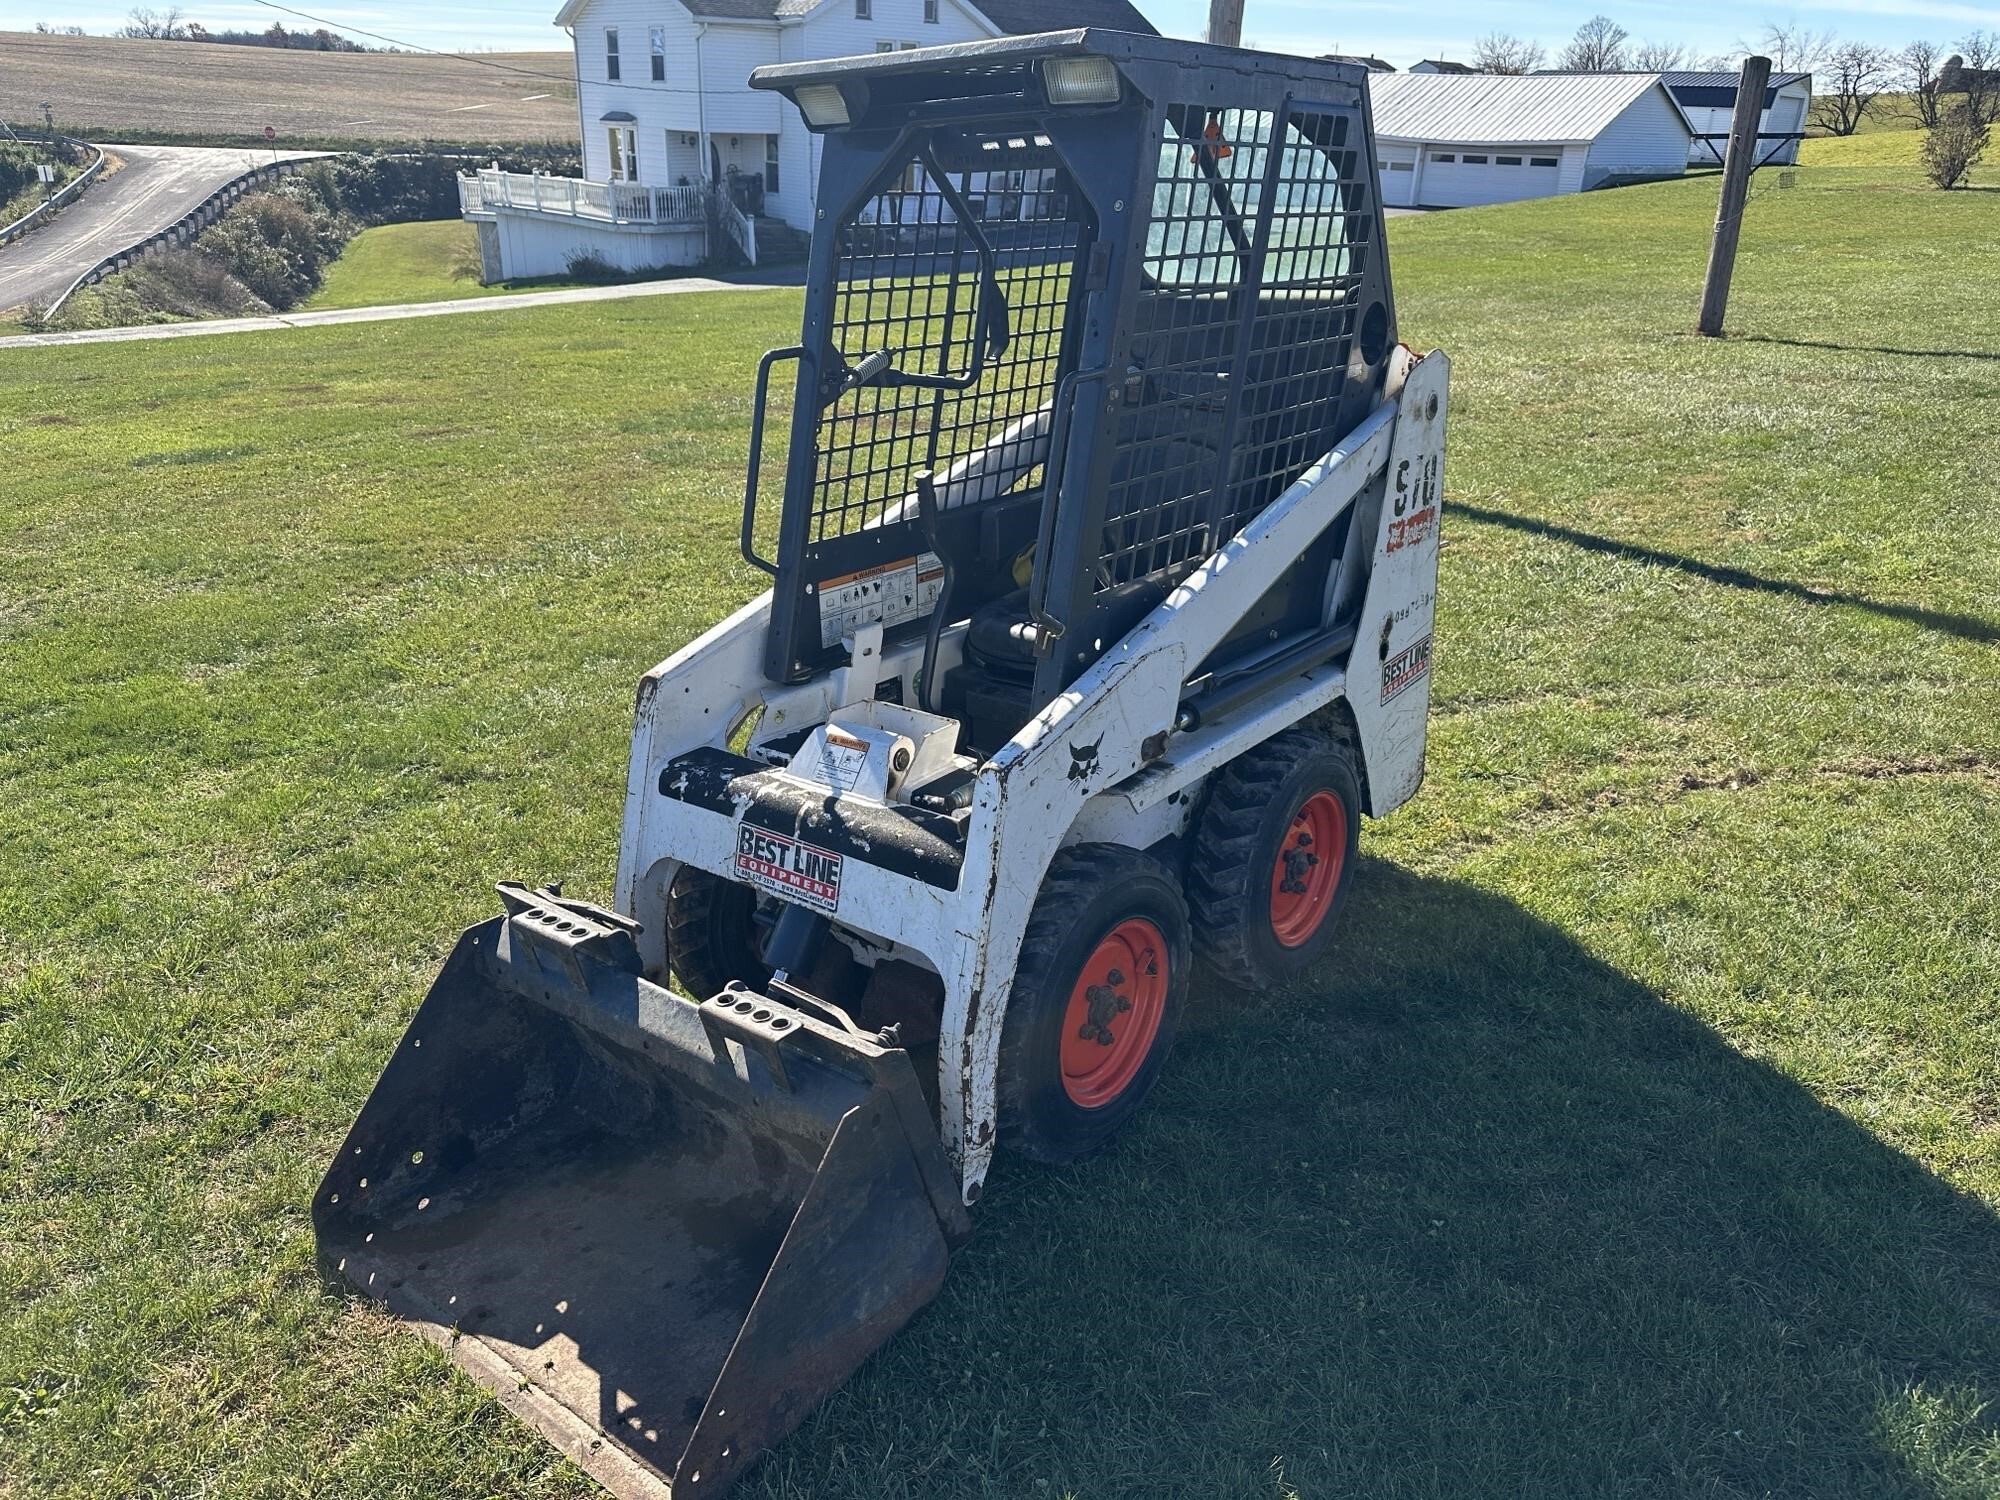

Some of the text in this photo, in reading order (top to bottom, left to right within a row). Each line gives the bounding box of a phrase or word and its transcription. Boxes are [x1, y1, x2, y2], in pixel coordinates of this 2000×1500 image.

[1383, 655, 1409, 687] BEST
[1409, 640, 1430, 669] LINE
[740, 826, 839, 886] BEST LINE
[740, 857, 834, 897] EQUIPMENT
